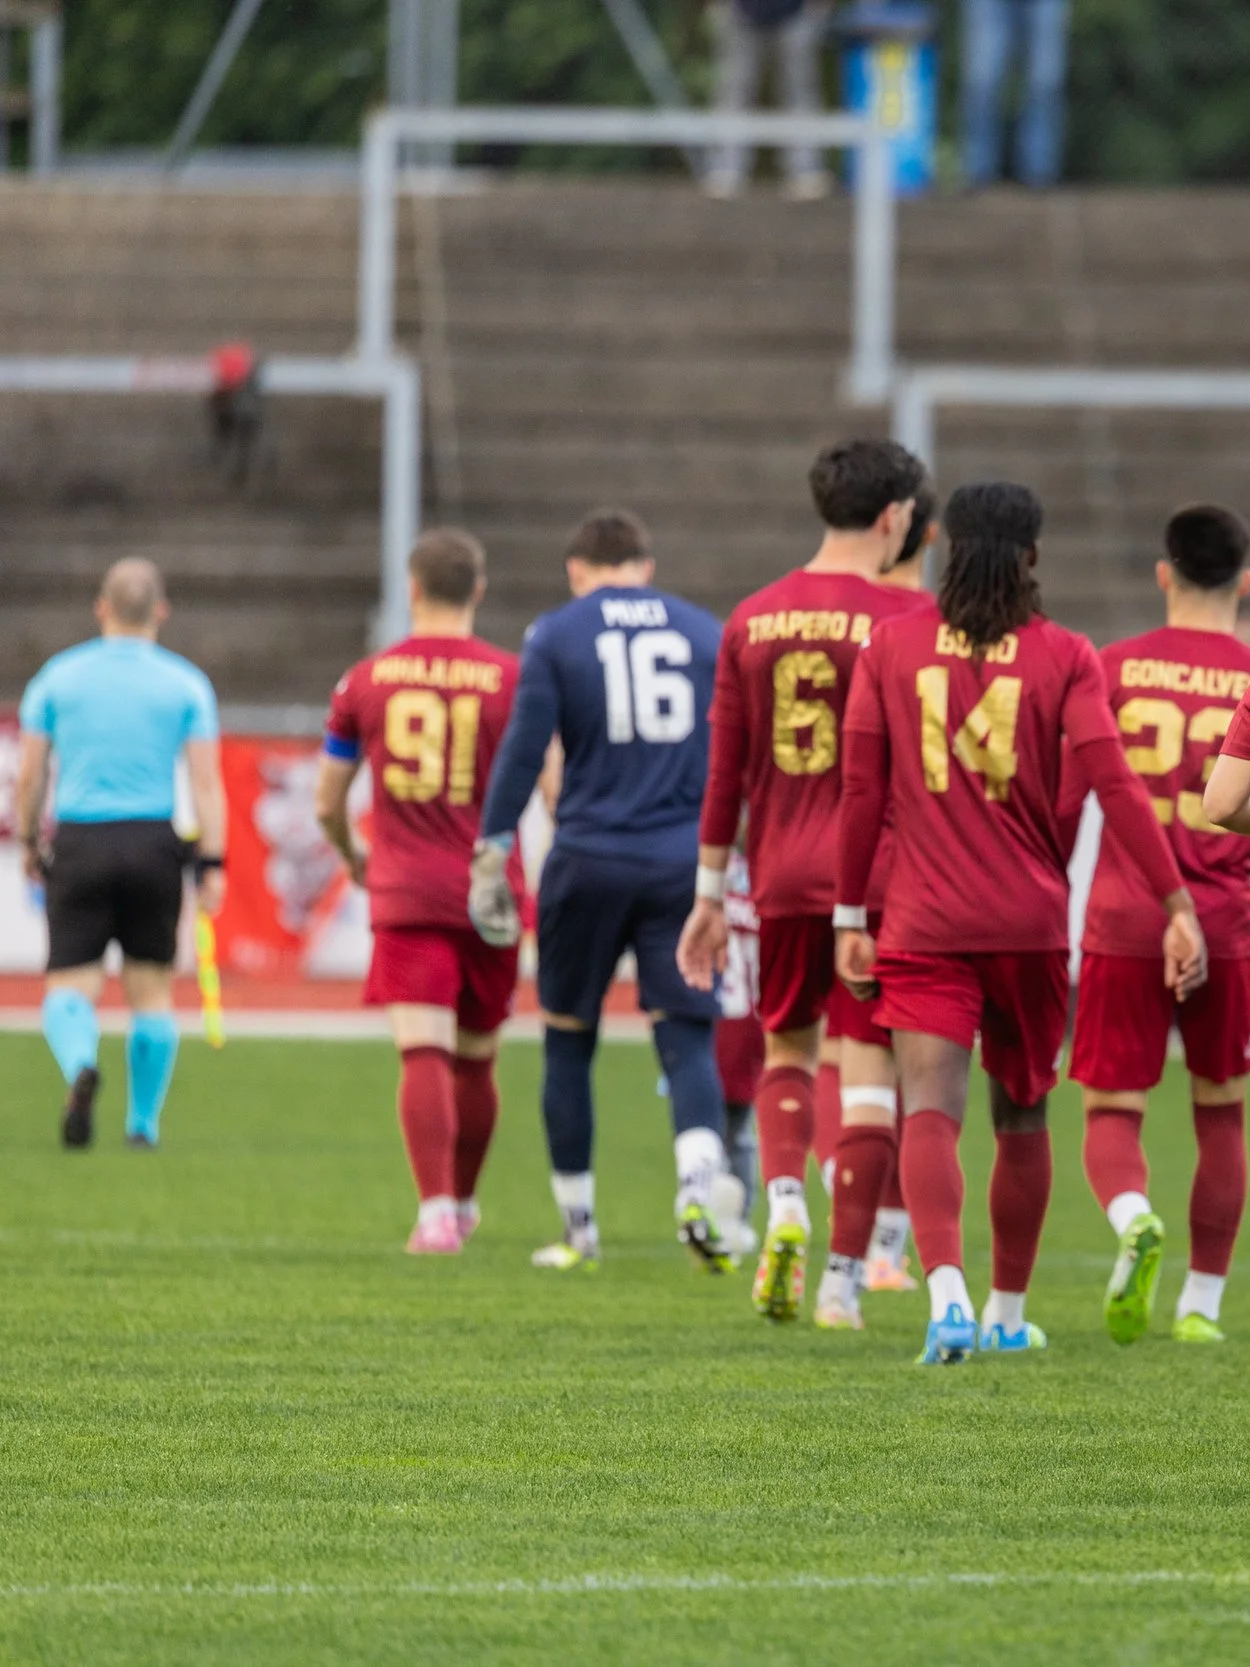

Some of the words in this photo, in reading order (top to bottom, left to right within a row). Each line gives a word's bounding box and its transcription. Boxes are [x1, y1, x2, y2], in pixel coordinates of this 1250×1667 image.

[596, 629, 696, 744] 16
[747, 610, 849, 645] TRAPERO
[383, 688, 481, 806] 91
[772, 650, 838, 775] 6
[916, 665, 1022, 803] 14
[1117, 697, 1238, 835] 23
